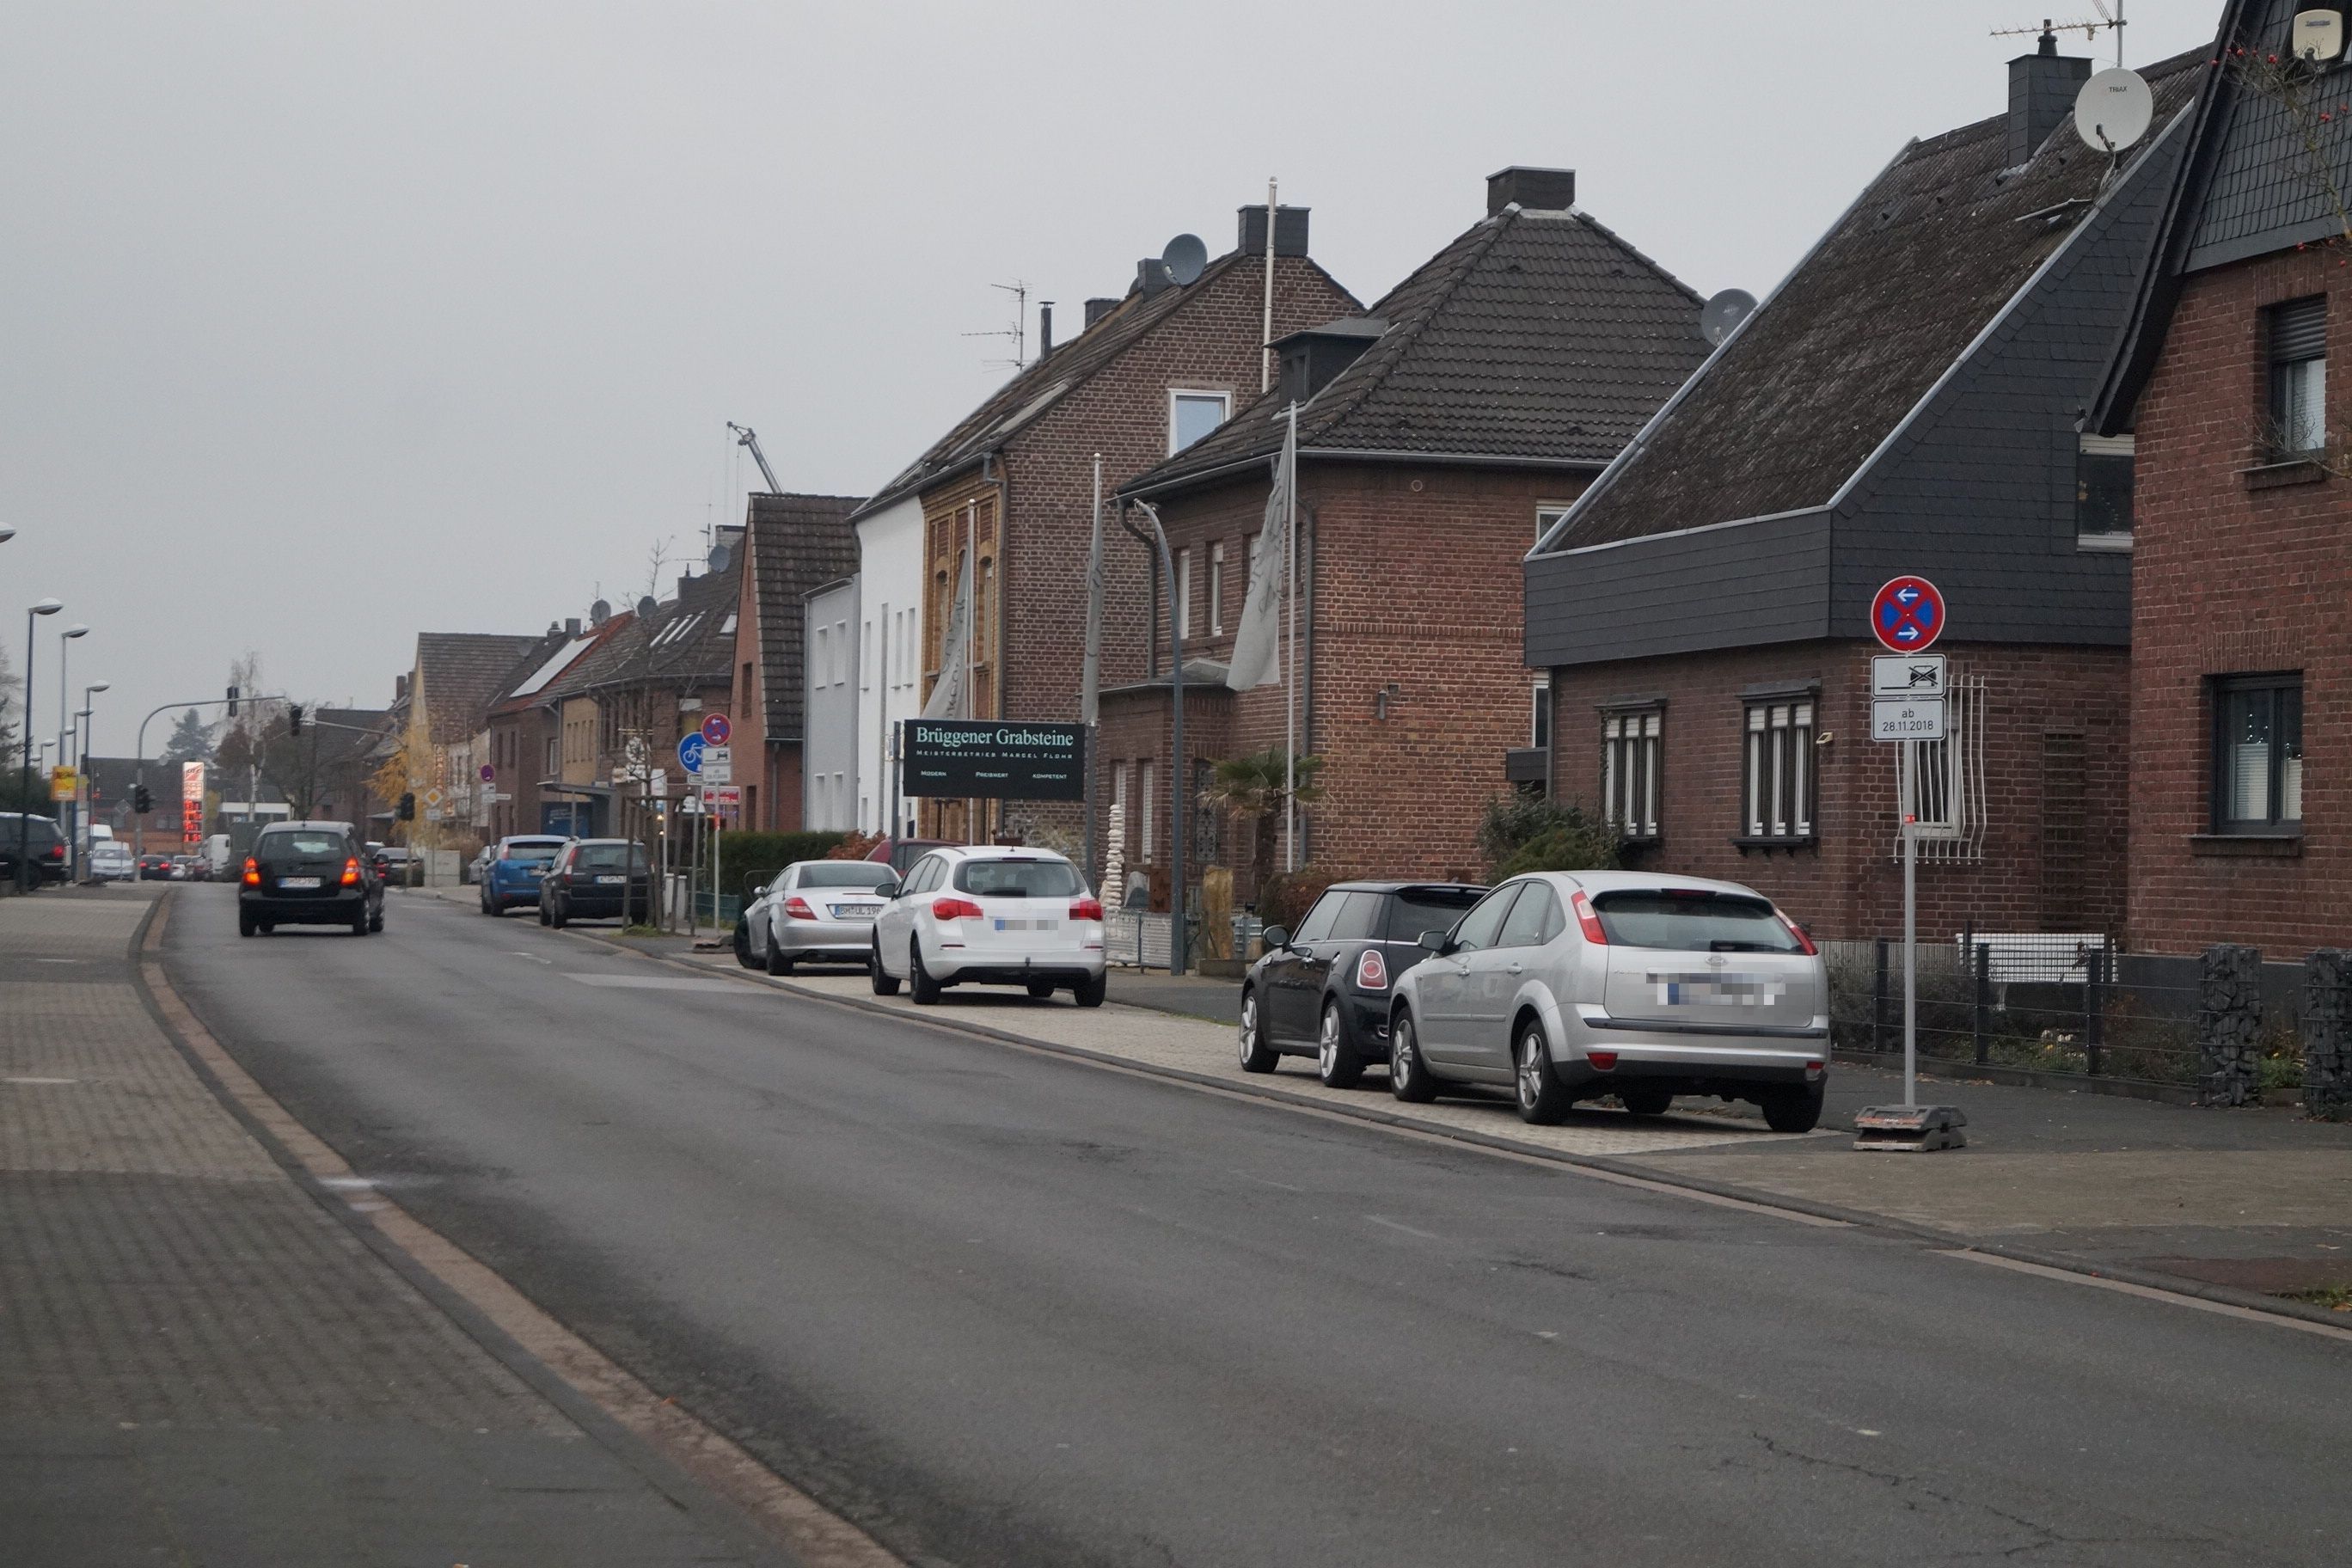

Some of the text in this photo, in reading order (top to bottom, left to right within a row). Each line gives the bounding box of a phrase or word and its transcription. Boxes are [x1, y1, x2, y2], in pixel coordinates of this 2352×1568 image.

[1902, 707, 1914, 719] ab
[1883, 720, 1933, 732] 28.11.2018
[916, 726, 1074, 748] Brüggener Grabsteine
